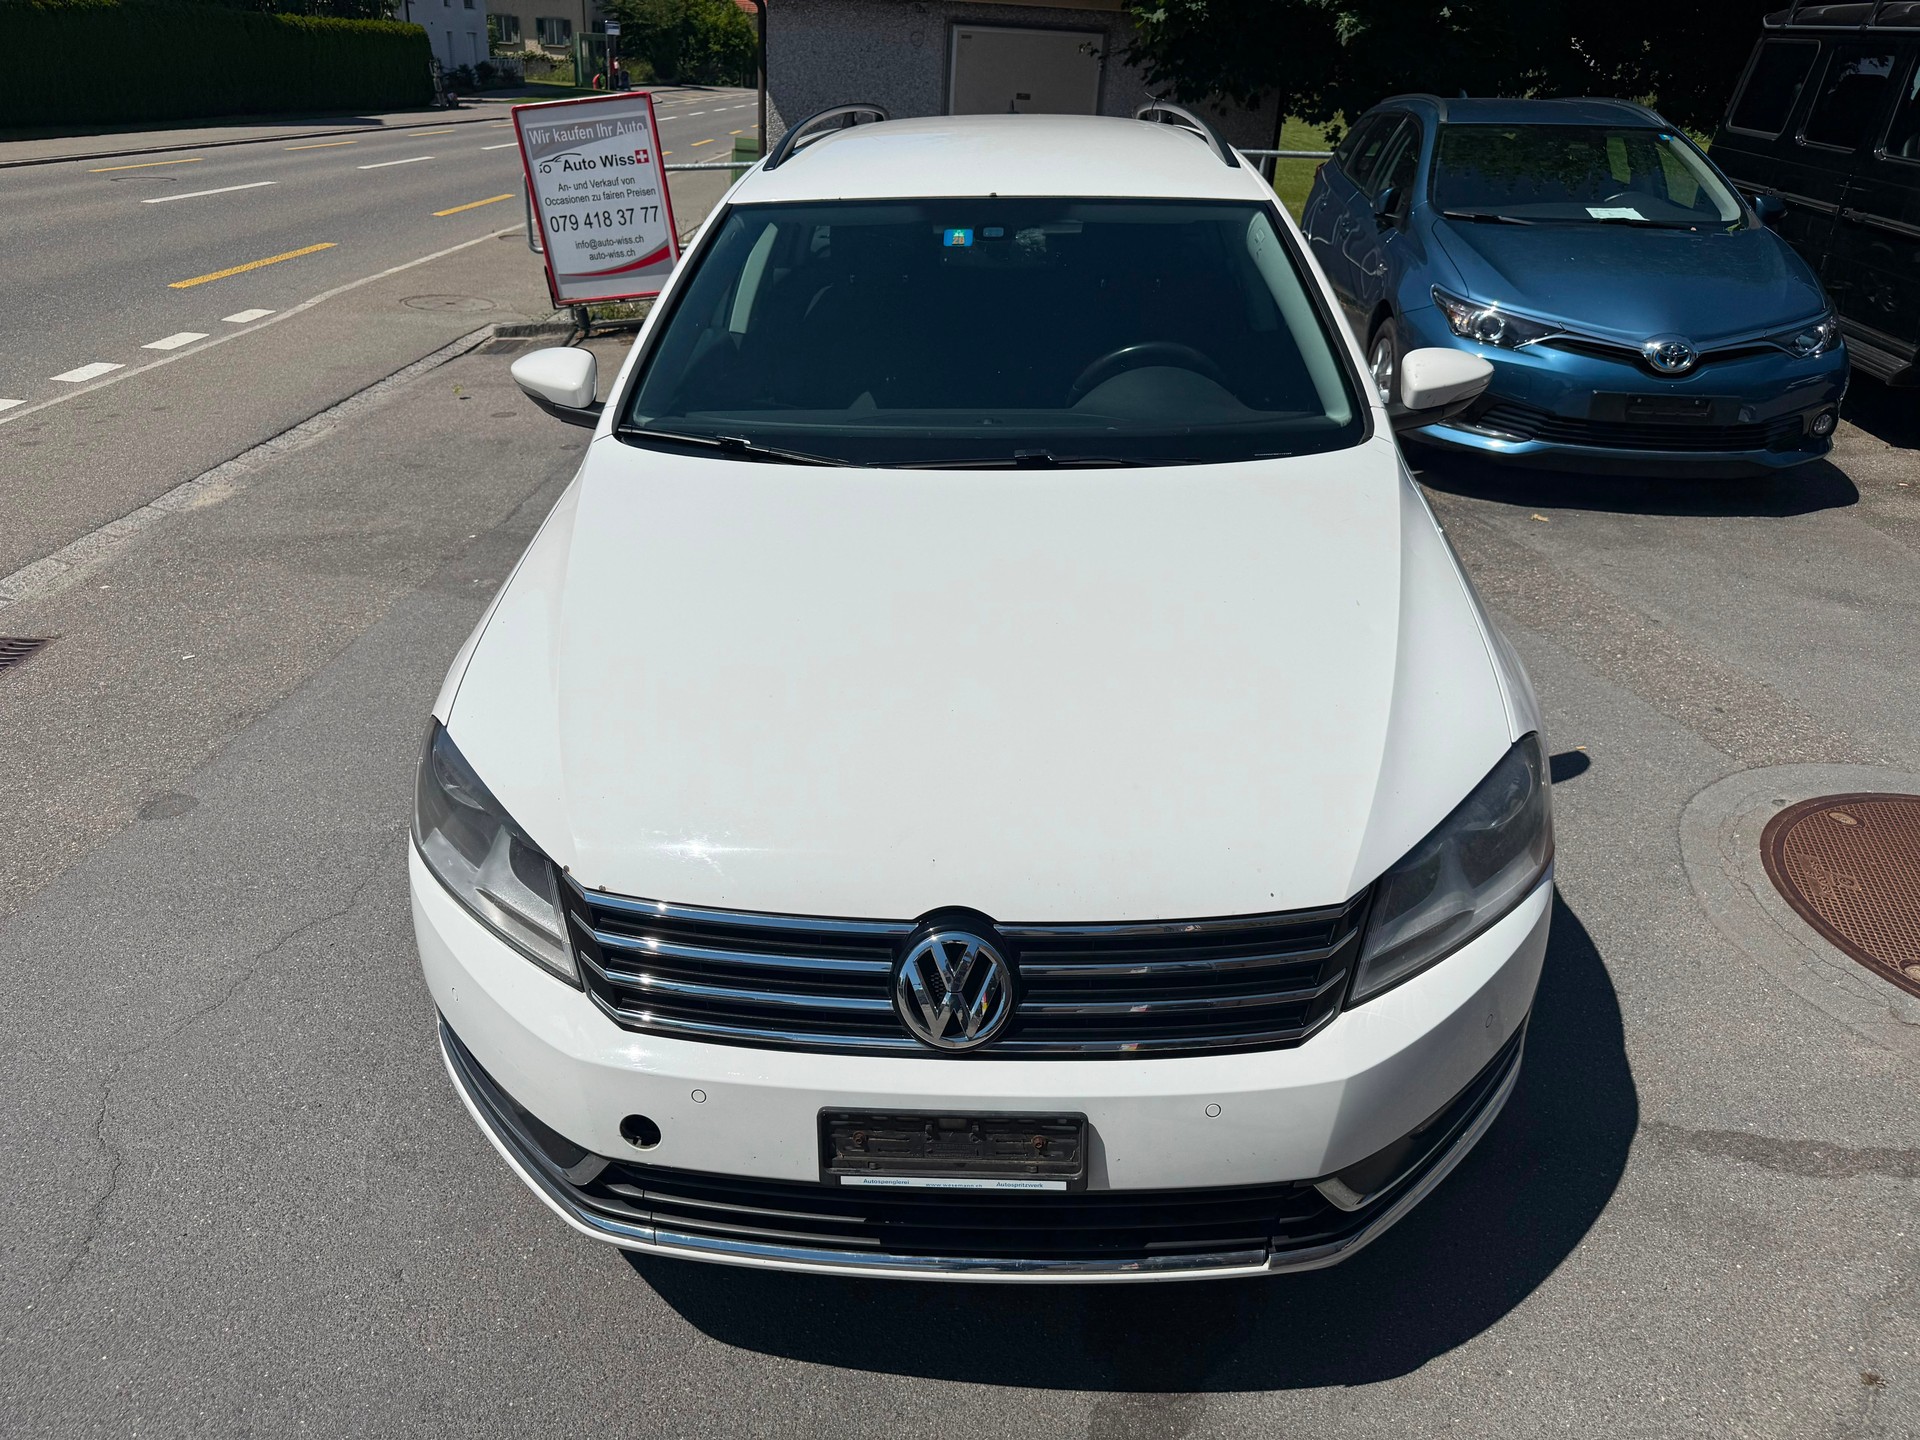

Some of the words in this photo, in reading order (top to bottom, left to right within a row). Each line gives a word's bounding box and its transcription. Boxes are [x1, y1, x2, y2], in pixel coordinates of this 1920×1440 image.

[529, 129, 550, 145] Wir
[553, 126, 594, 143] kaufen
[596, 123, 613, 138] Ihr
[563, 159, 596, 172] Auto
[599, 154, 635, 168] Wiss
[558, 183, 571, 192] An-
[573, 181, 588, 191] und
[589, 177, 619, 188] Verkauf
[621, 176, 636, 185] von
[545, 196, 590, 206] Occasionen
[592, 193, 602, 202] zu
[602, 190, 625, 201] fairen
[626, 187, 656, 198] Preisen
[550, 213, 579, 233] 079
[584, 210, 613, 229] 418
[616, 208, 635, 226] 37
[640, 206, 658, 223] 77
[575, 234, 645, 250] info@auto-wiss.ch
[589, 248, 636, 261] auto-wiss.ch
[863, 1178, 910, 1186] Autospenglerei
[996, 1181, 1044, 1189] Autospritzwerk
